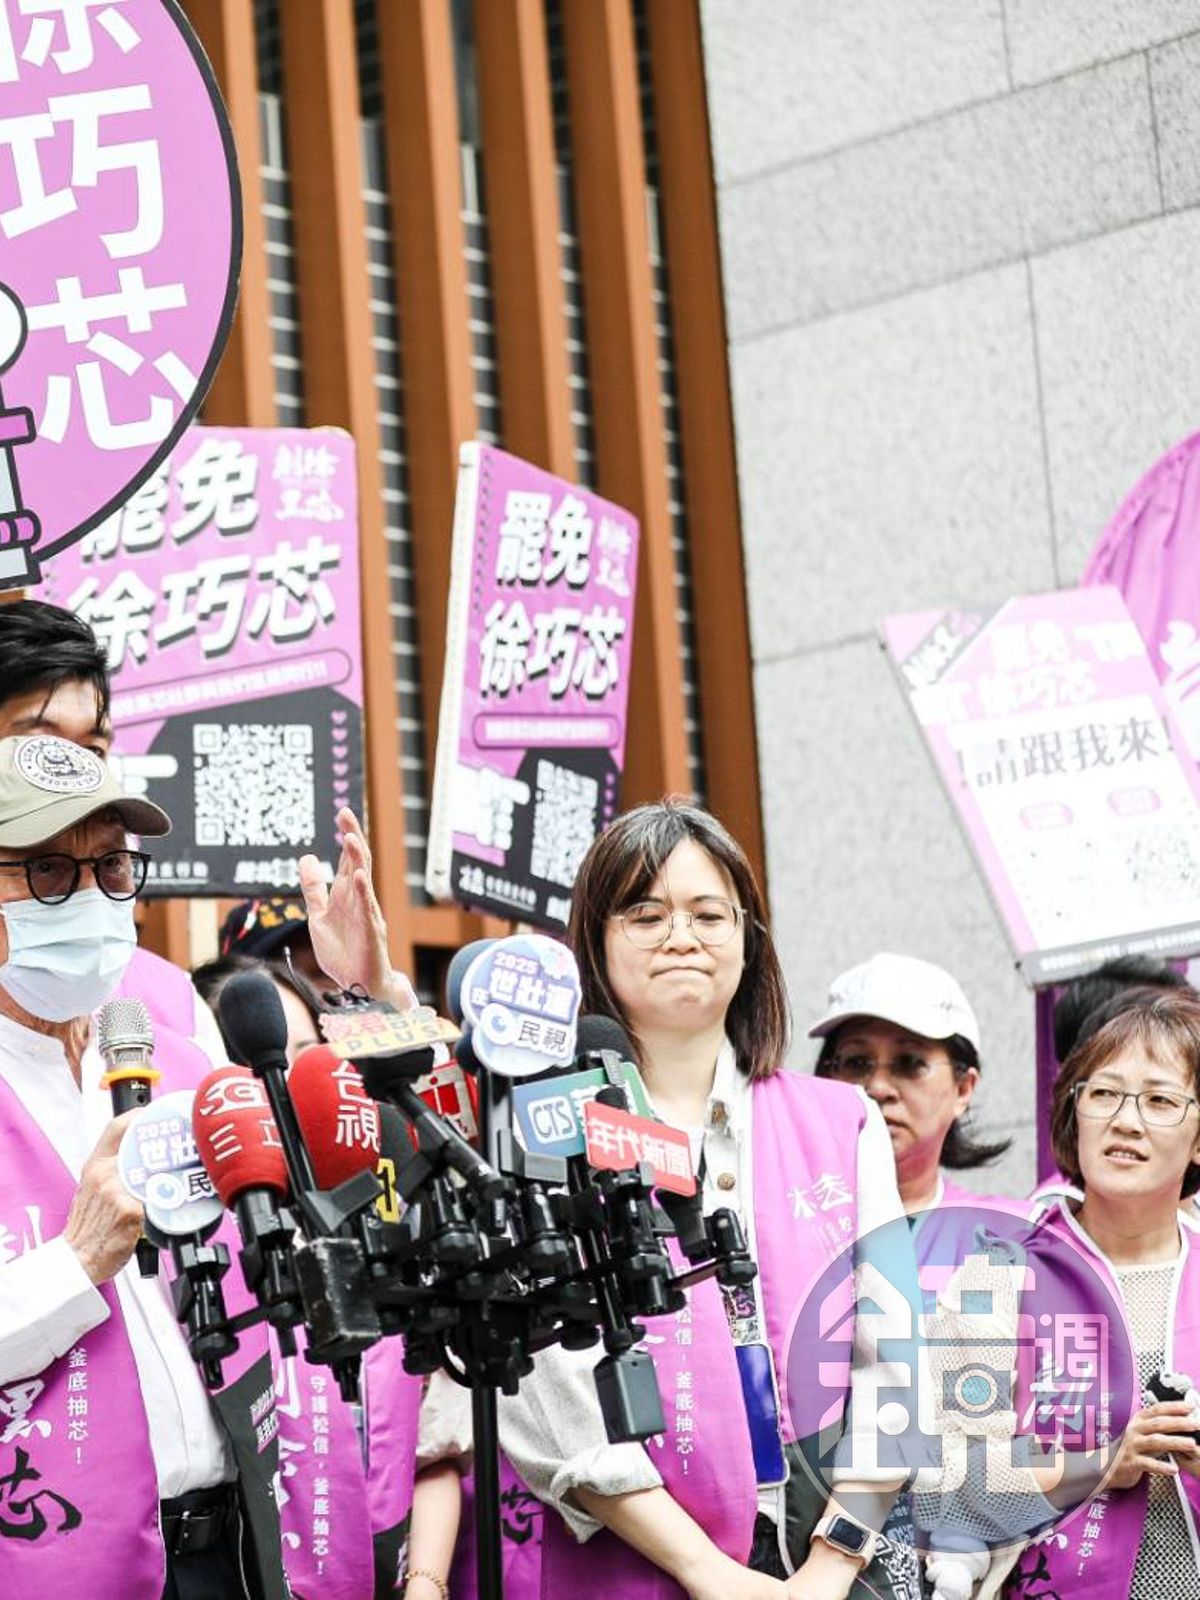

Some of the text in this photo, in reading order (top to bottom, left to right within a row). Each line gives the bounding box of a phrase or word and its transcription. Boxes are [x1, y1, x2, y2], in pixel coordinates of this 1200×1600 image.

[496, 490, 593, 587] 罷免
[67, 536, 341, 673] 徐巧芯
[480, 600, 626, 697] 徐巧芯
[494, 951, 539, 975] 2025
[518, 1020, 567, 1053] 民視
[331, 1060, 381, 1152] 台視
[532, 1099, 574, 1138] CTS
